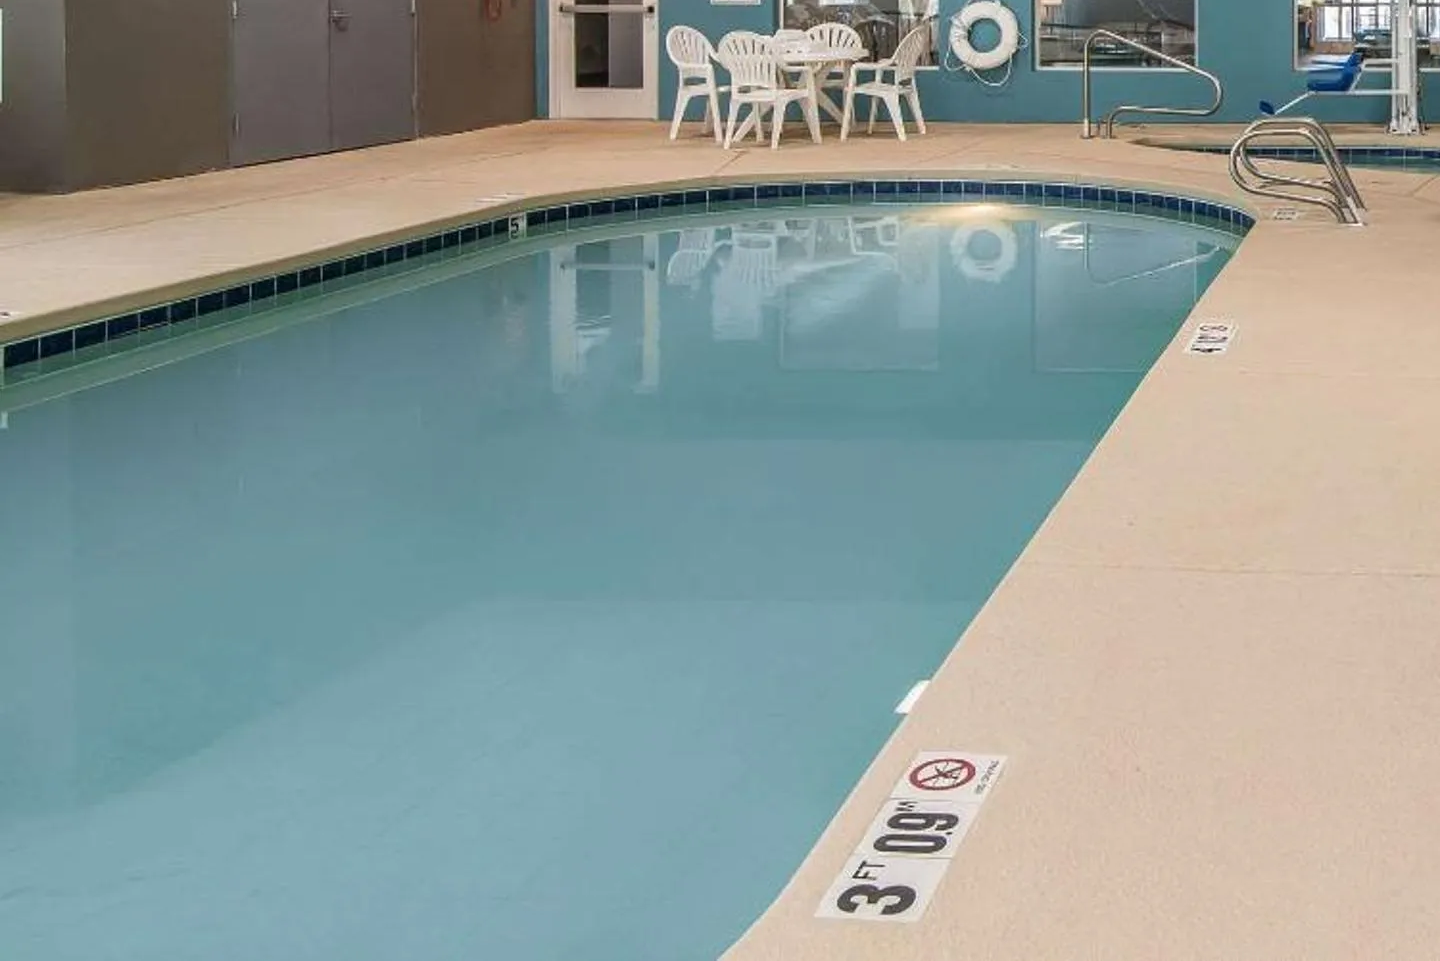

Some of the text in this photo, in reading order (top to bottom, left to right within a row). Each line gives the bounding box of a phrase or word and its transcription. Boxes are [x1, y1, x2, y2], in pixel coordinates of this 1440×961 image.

[837, 801, 959, 916] 3 FT 0.9 M
